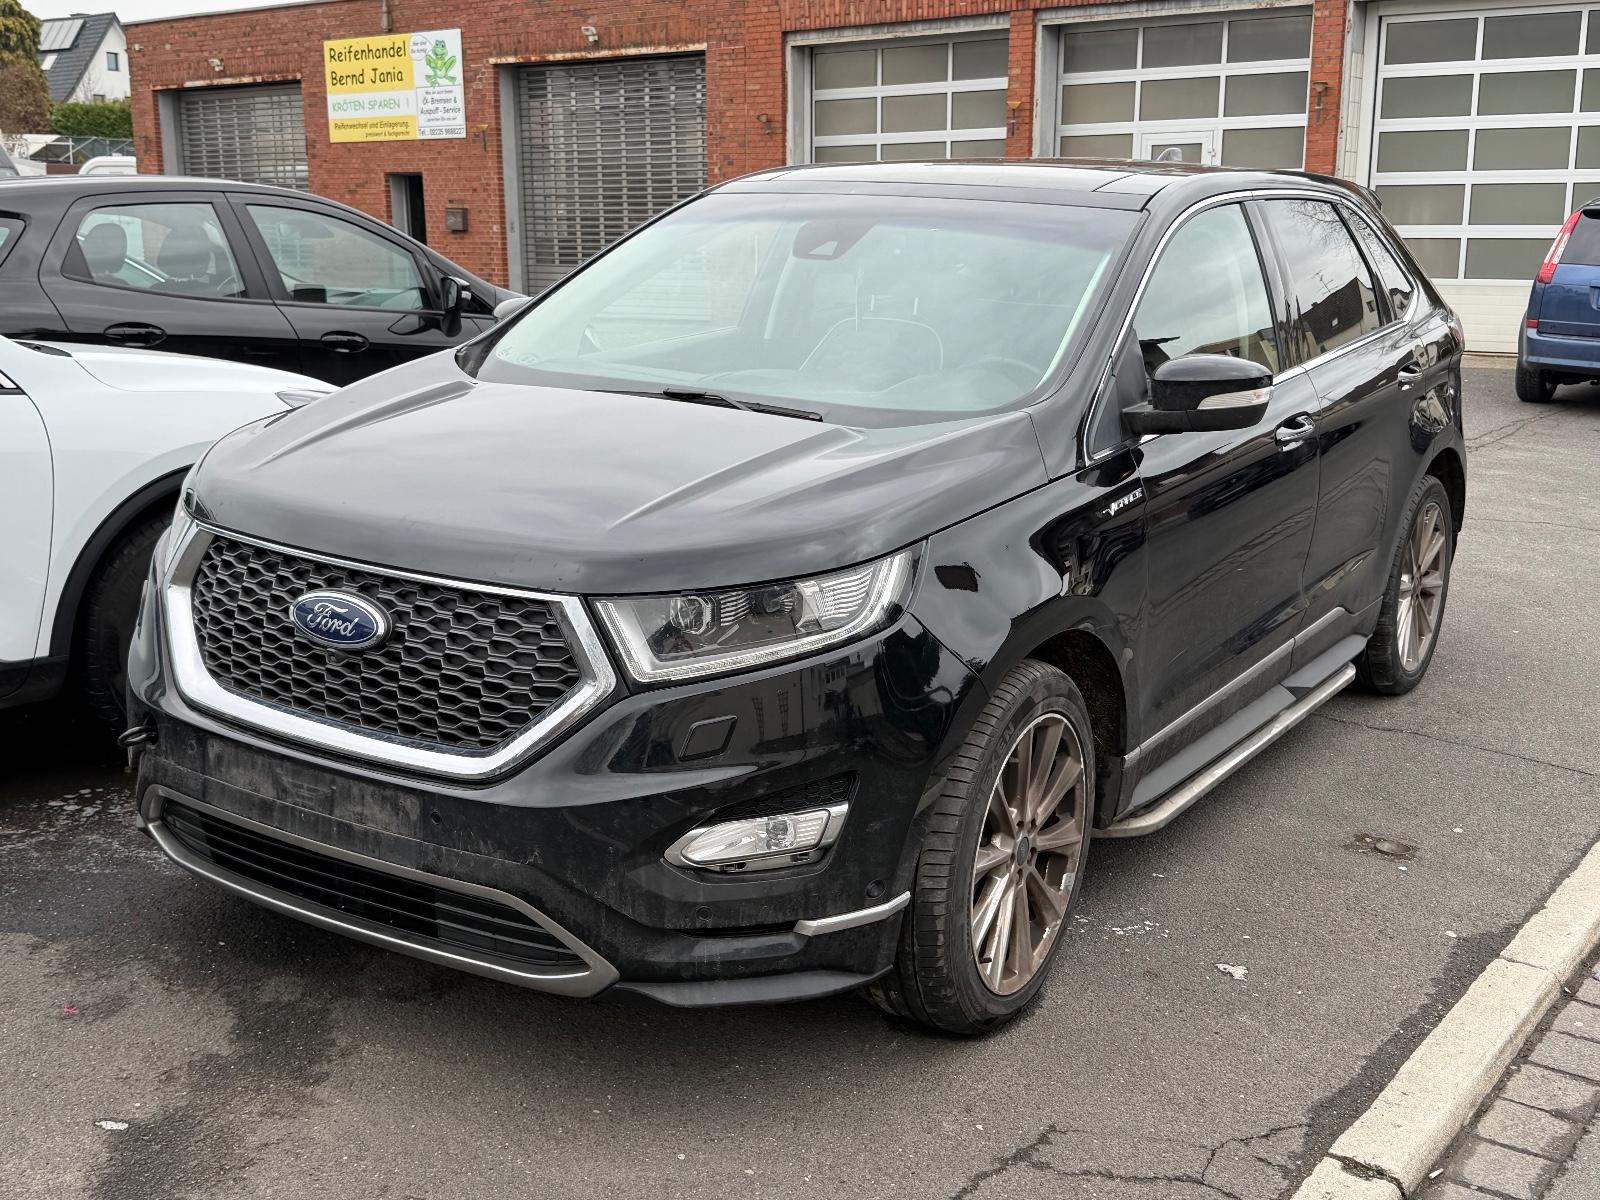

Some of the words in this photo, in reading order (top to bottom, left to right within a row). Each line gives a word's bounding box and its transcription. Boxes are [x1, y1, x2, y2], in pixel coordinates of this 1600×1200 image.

[329, 41, 406, 63] Reifenhandel
[331, 69, 365, 86] Bernd
[371, 67, 404, 84] Jania
[332, 100, 365, 112] KRÖTEN
[368, 98, 401, 110] SPAREN
[443, 106, 461, 114] Service
[334, 122, 368, 130] Reifenwechsel
[307, 602, 360, 637] Ford
